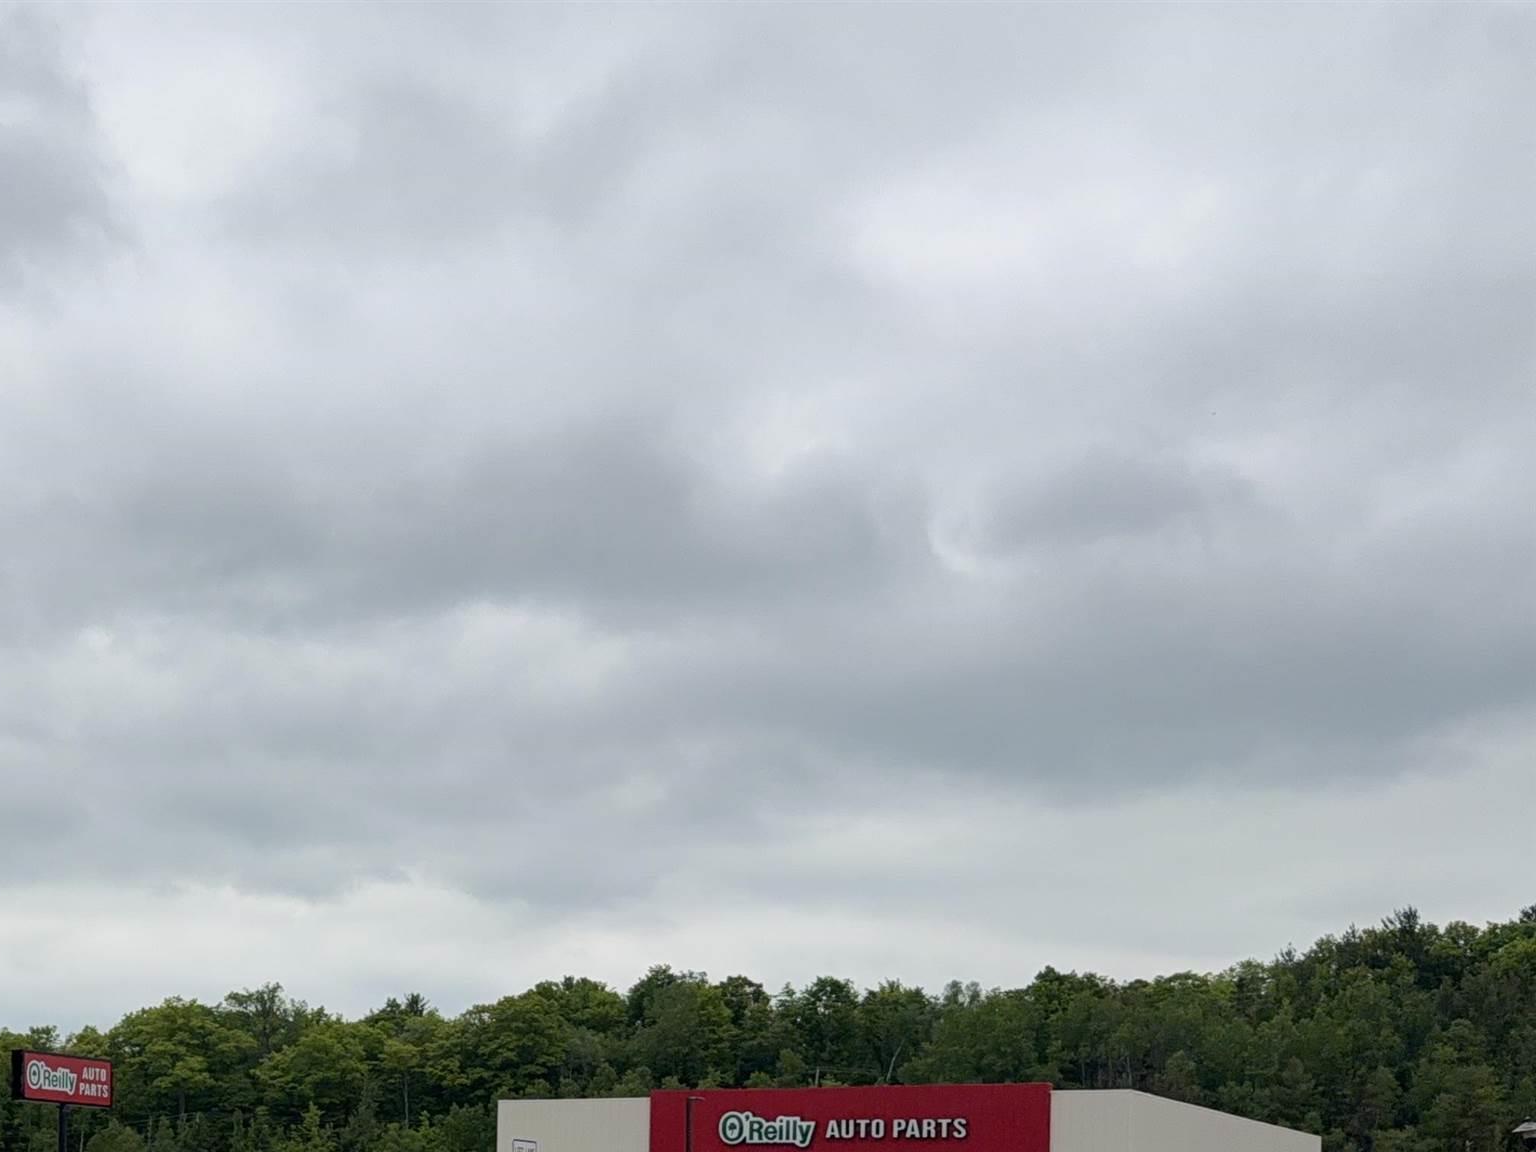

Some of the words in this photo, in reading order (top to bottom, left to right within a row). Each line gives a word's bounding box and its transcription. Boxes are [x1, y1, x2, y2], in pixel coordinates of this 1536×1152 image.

[28, 1060, 77, 1095] O'Reilly
[82, 1067, 106, 1082] AUTO
[79, 1083, 109, 1098] PARTS
[719, 1111, 816, 1147] O'Reilly
[826, 1119, 884, 1138] AUTO
[893, 1119, 967, 1138] PARTS
